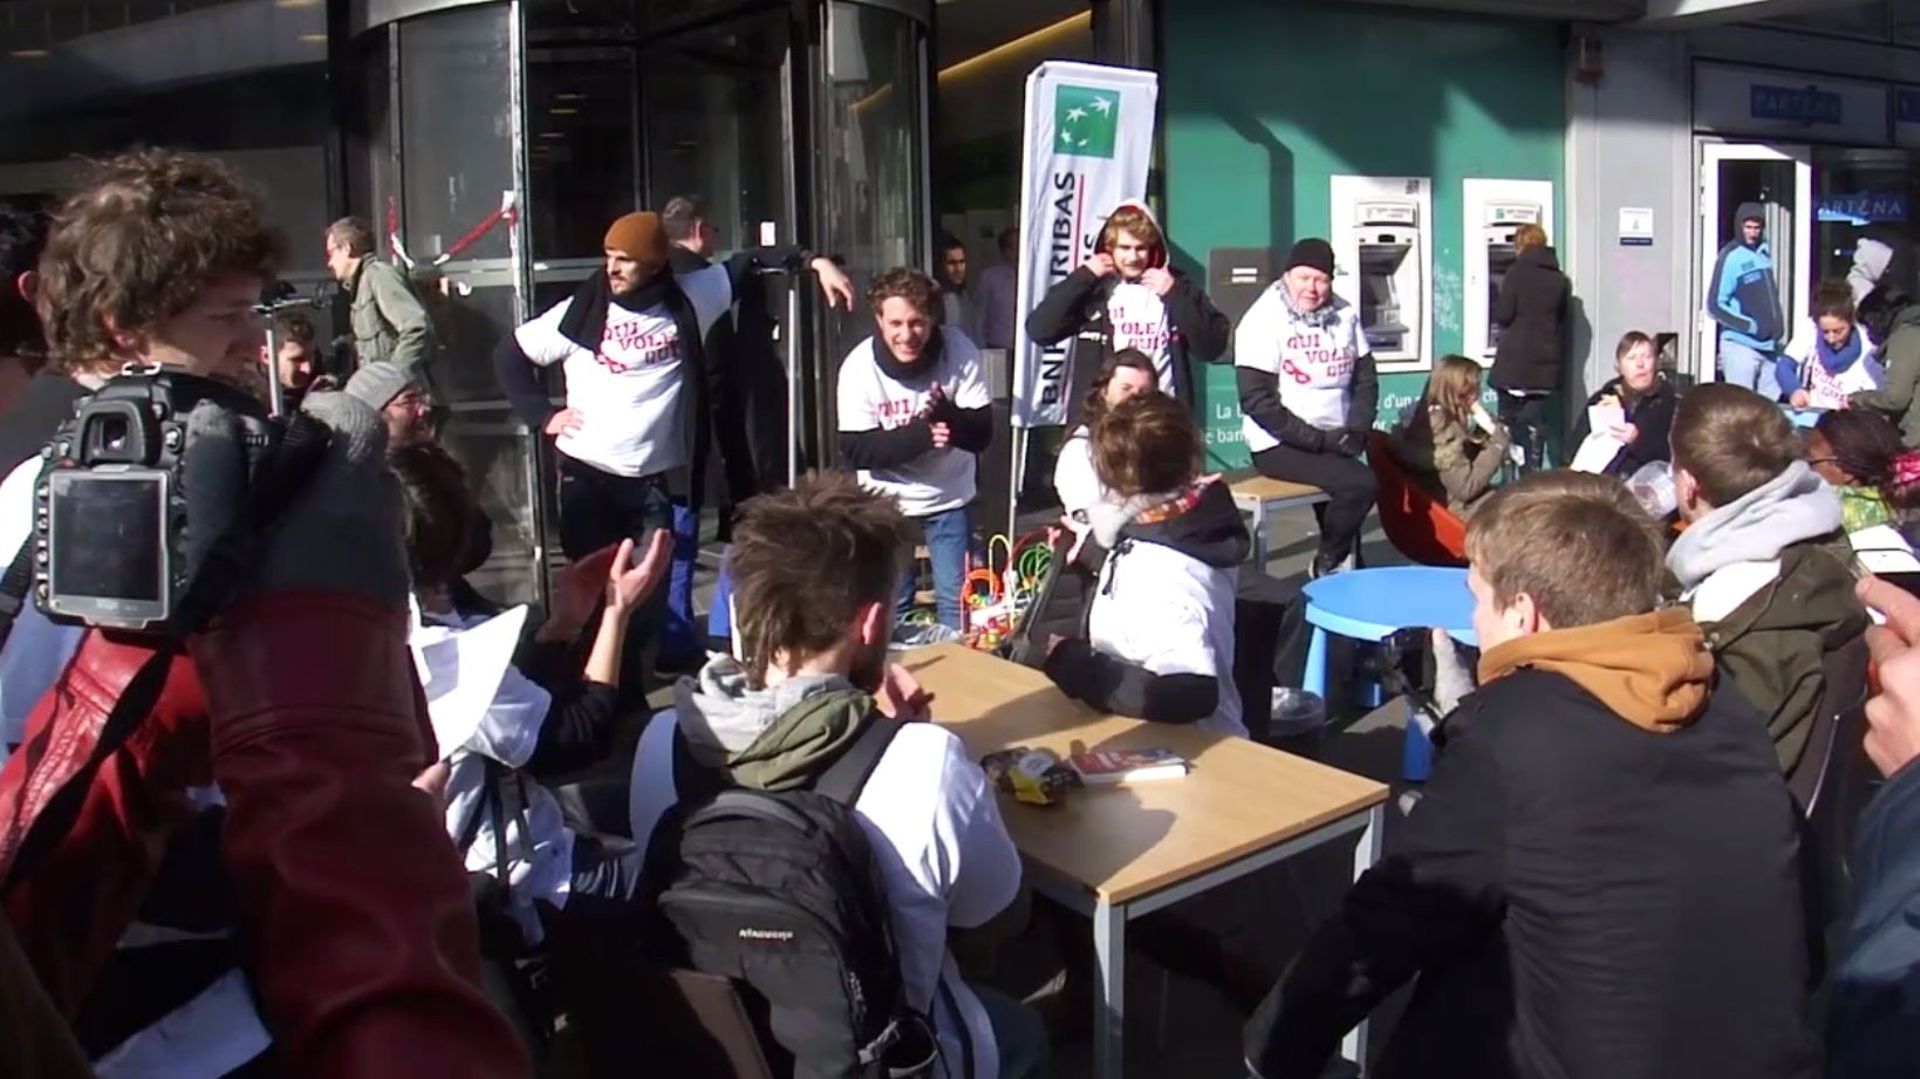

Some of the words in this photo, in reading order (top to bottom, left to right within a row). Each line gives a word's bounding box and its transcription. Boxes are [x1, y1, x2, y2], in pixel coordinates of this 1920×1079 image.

[1049, 172, 1075, 276] RIBAS
[1121, 321, 1156, 335] OLE
[1287, 334, 1320, 349] QUI
[1216, 403, 1232, 419] La
[1217, 427, 1247, 443] ban
